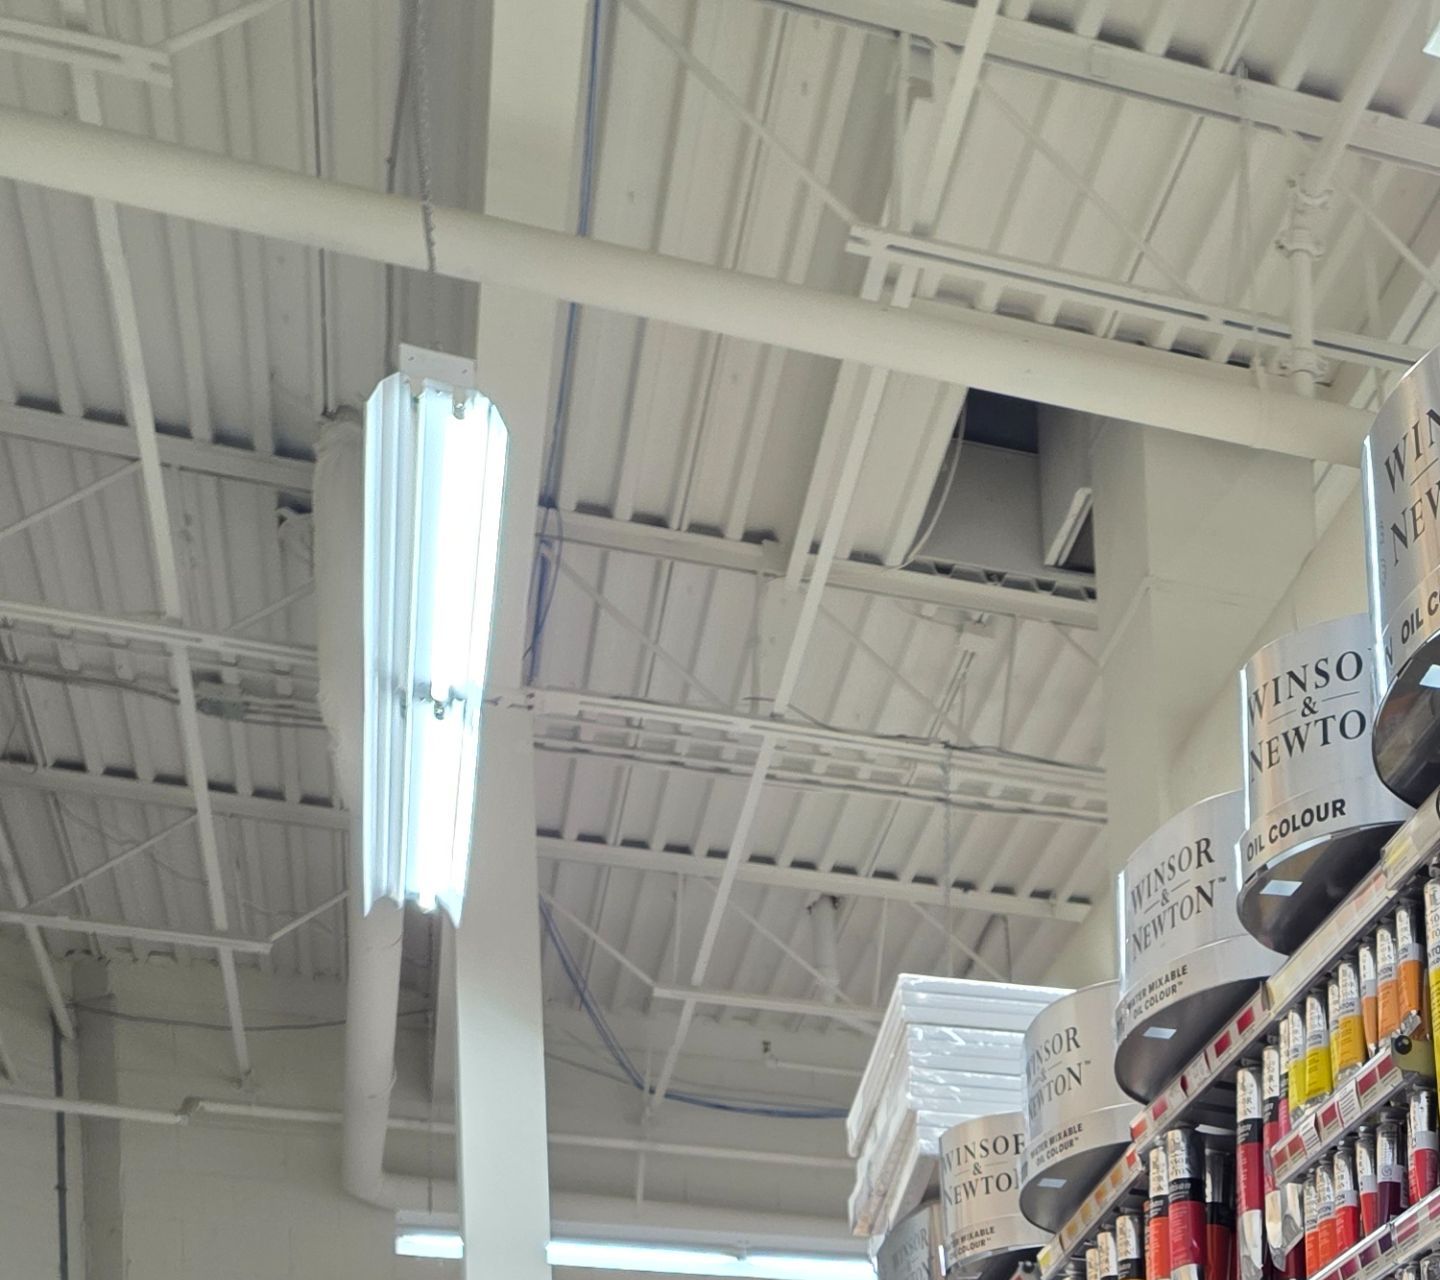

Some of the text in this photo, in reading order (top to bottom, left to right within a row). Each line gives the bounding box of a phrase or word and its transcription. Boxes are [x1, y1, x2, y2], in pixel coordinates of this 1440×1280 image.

[1400, 608, 1424, 645] OIL
[1248, 651, 1363, 728] WINSO
[1301, 696, 1318, 718] &
[1250, 709, 1366, 783] NEWTO
[1246, 798, 1347, 862] OIL COLOUR
[1130, 837, 1215, 915] WINSOR
[1147, 964, 1188, 995] MIXABLE
